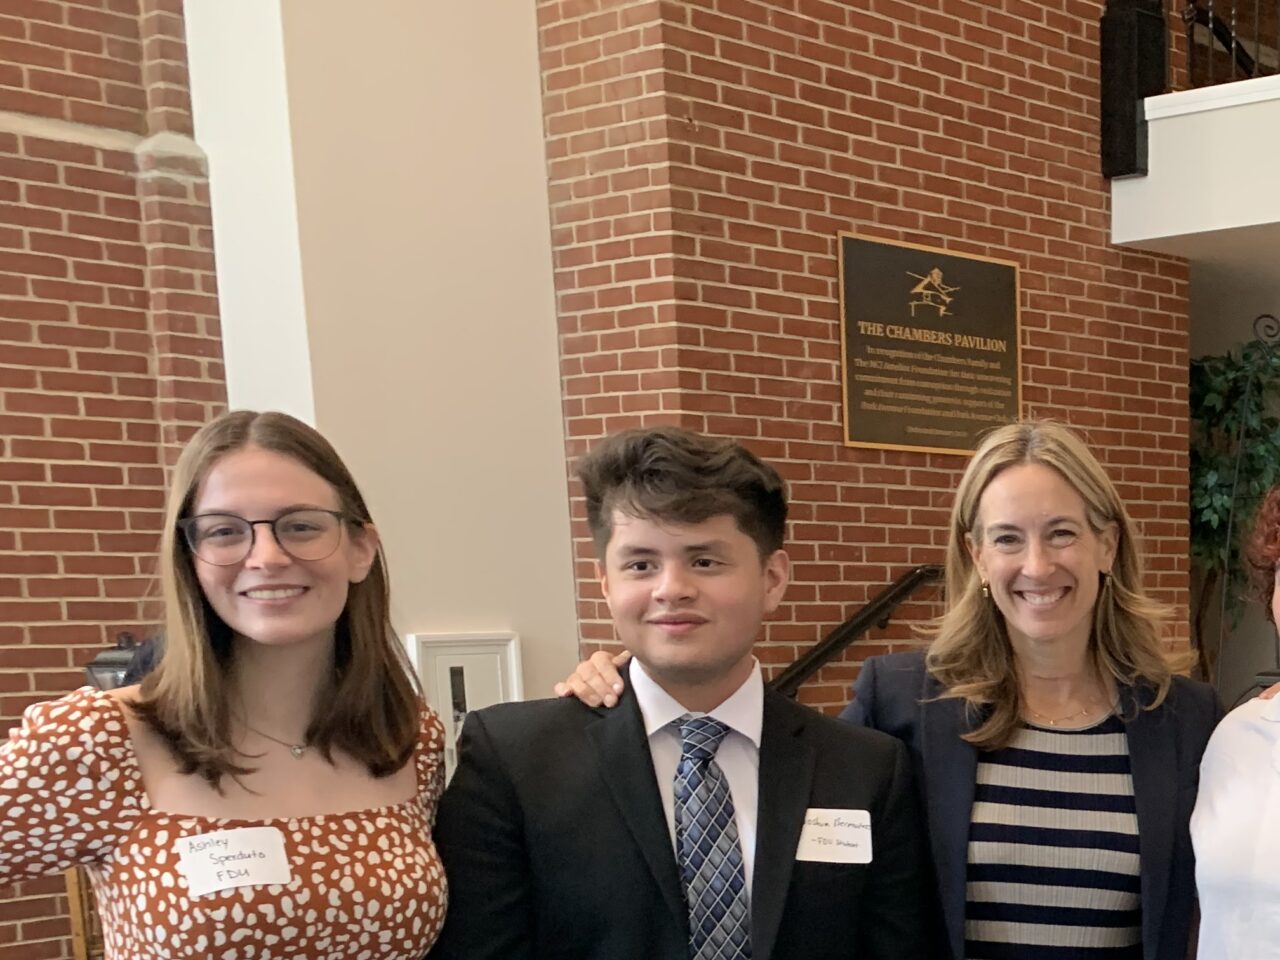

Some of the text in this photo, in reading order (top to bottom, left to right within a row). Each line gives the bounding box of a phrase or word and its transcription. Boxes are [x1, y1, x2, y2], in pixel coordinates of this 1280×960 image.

[858, 321, 1007, 352] THE CHAMBERS PAVILION
[188, 838, 228, 854] Ashley
[216, 868, 250, 882] FDU
